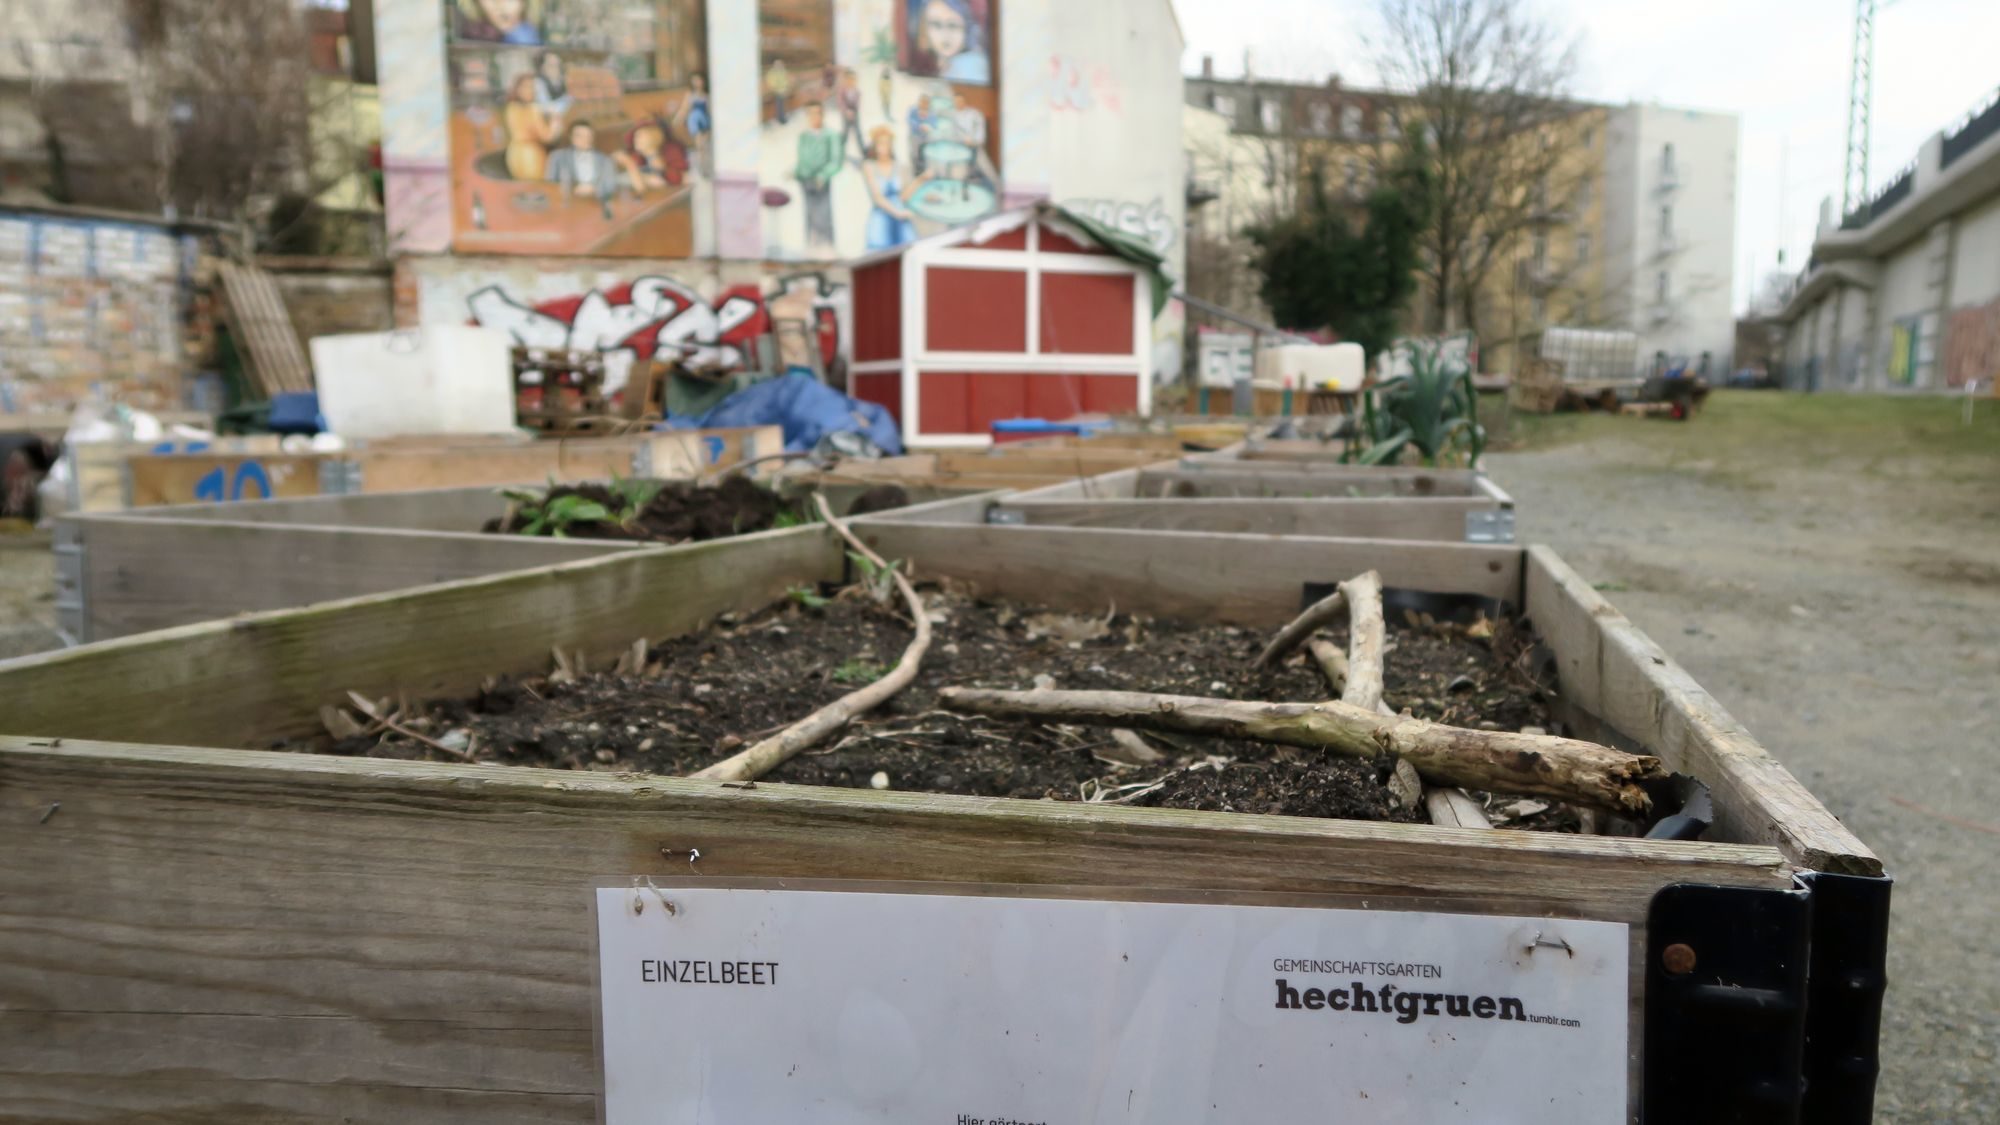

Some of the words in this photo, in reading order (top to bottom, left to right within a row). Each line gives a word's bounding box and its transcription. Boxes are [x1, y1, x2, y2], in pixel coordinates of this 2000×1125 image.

[642, 960, 779, 985] EINZELBEET
[1273, 958, 1442, 978] GEMEINSCHAFTSGARTEN
[957, 1114, 984, 1125] Hier
